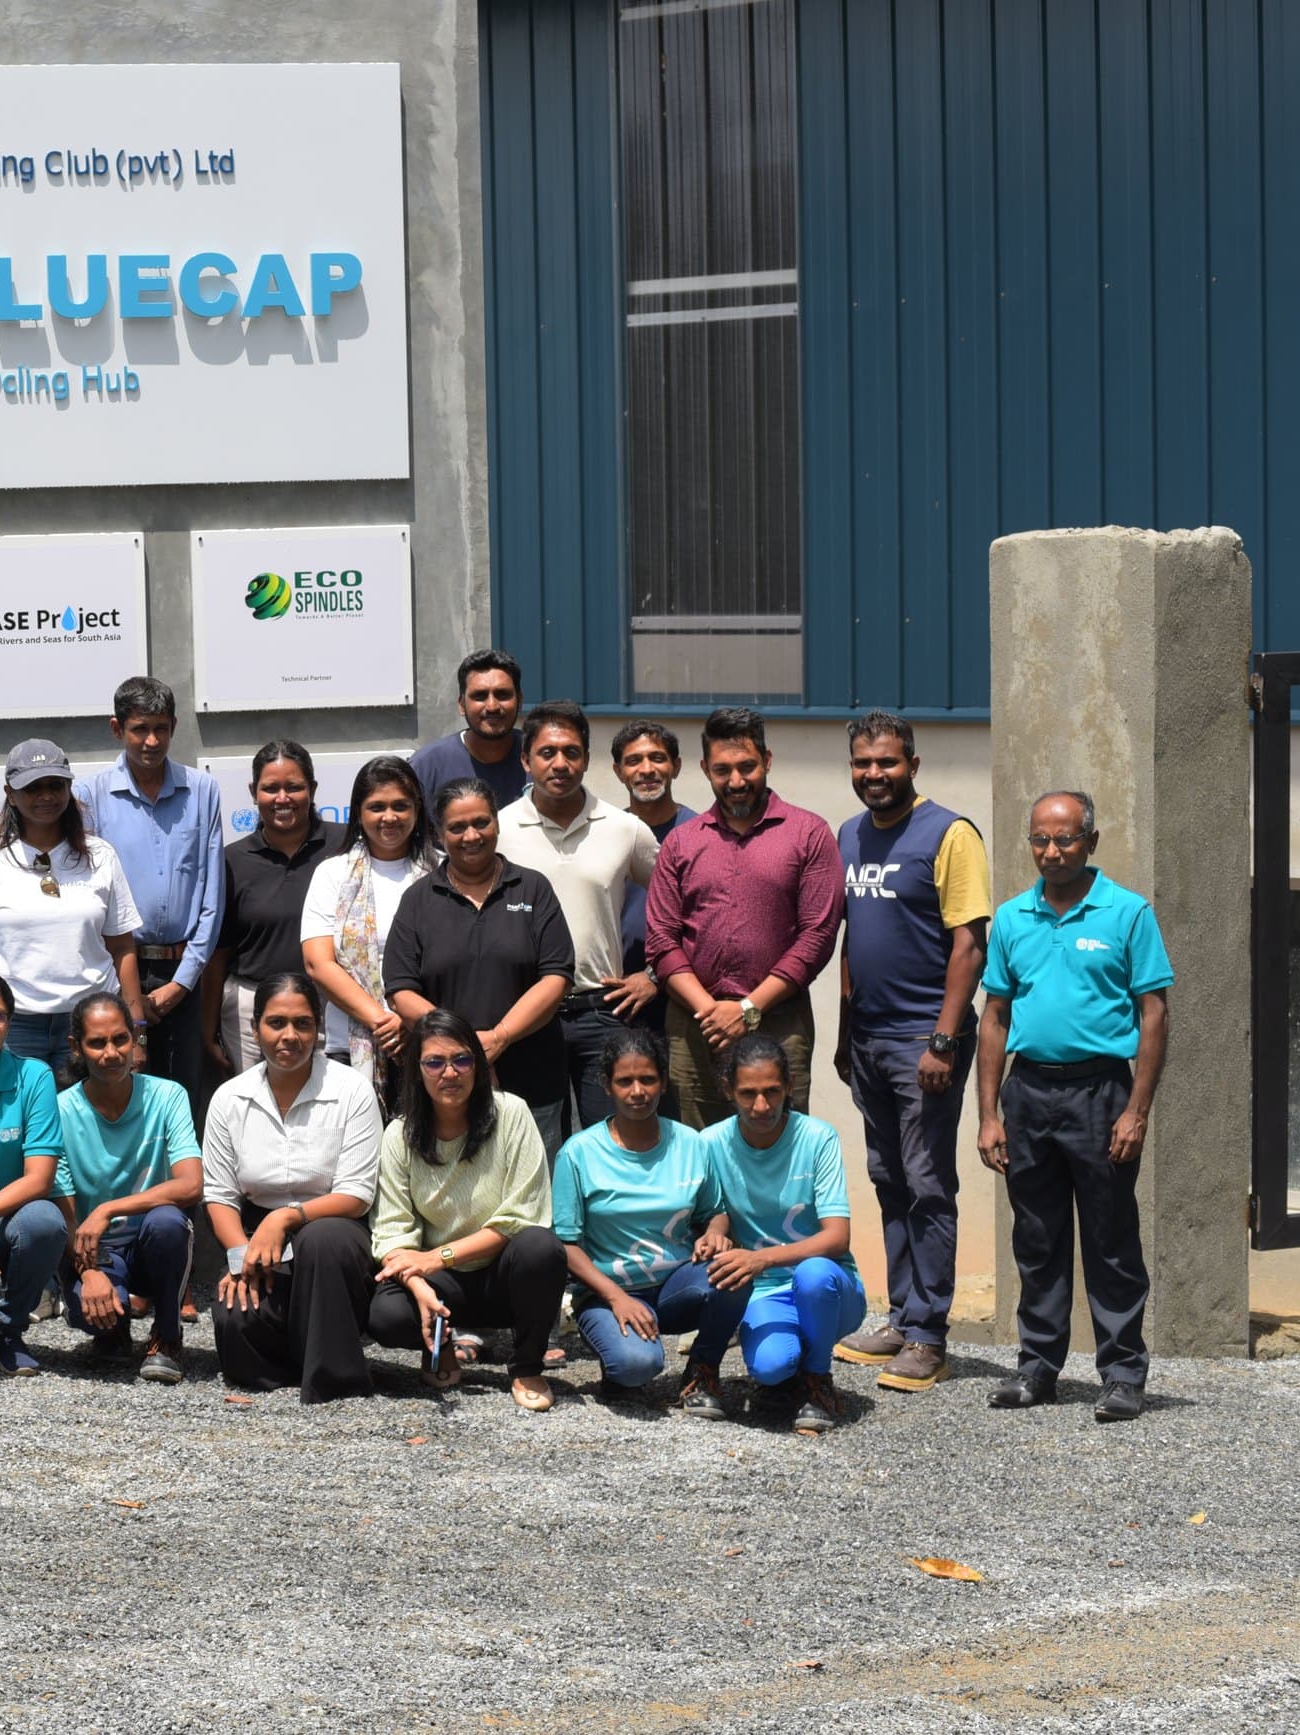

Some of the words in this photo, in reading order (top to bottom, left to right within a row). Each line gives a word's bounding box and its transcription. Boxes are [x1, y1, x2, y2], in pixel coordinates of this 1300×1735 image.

[44, 151, 109, 176] Club
[115, 148, 182, 181] (pvt)
[194, 148, 235, 174] Ltd
[82, 364, 140, 393] Hub
[294, 569, 363, 589] ECO
[295, 590, 363, 614] SPINDLES
[25, 636, 41, 644] and
[43, 636, 62, 644] Seas
[63, 634, 76, 643] for
[77, 633, 102, 643] South
[103, 633, 122, 642] Asia
[845, 863, 901, 898] NRC
